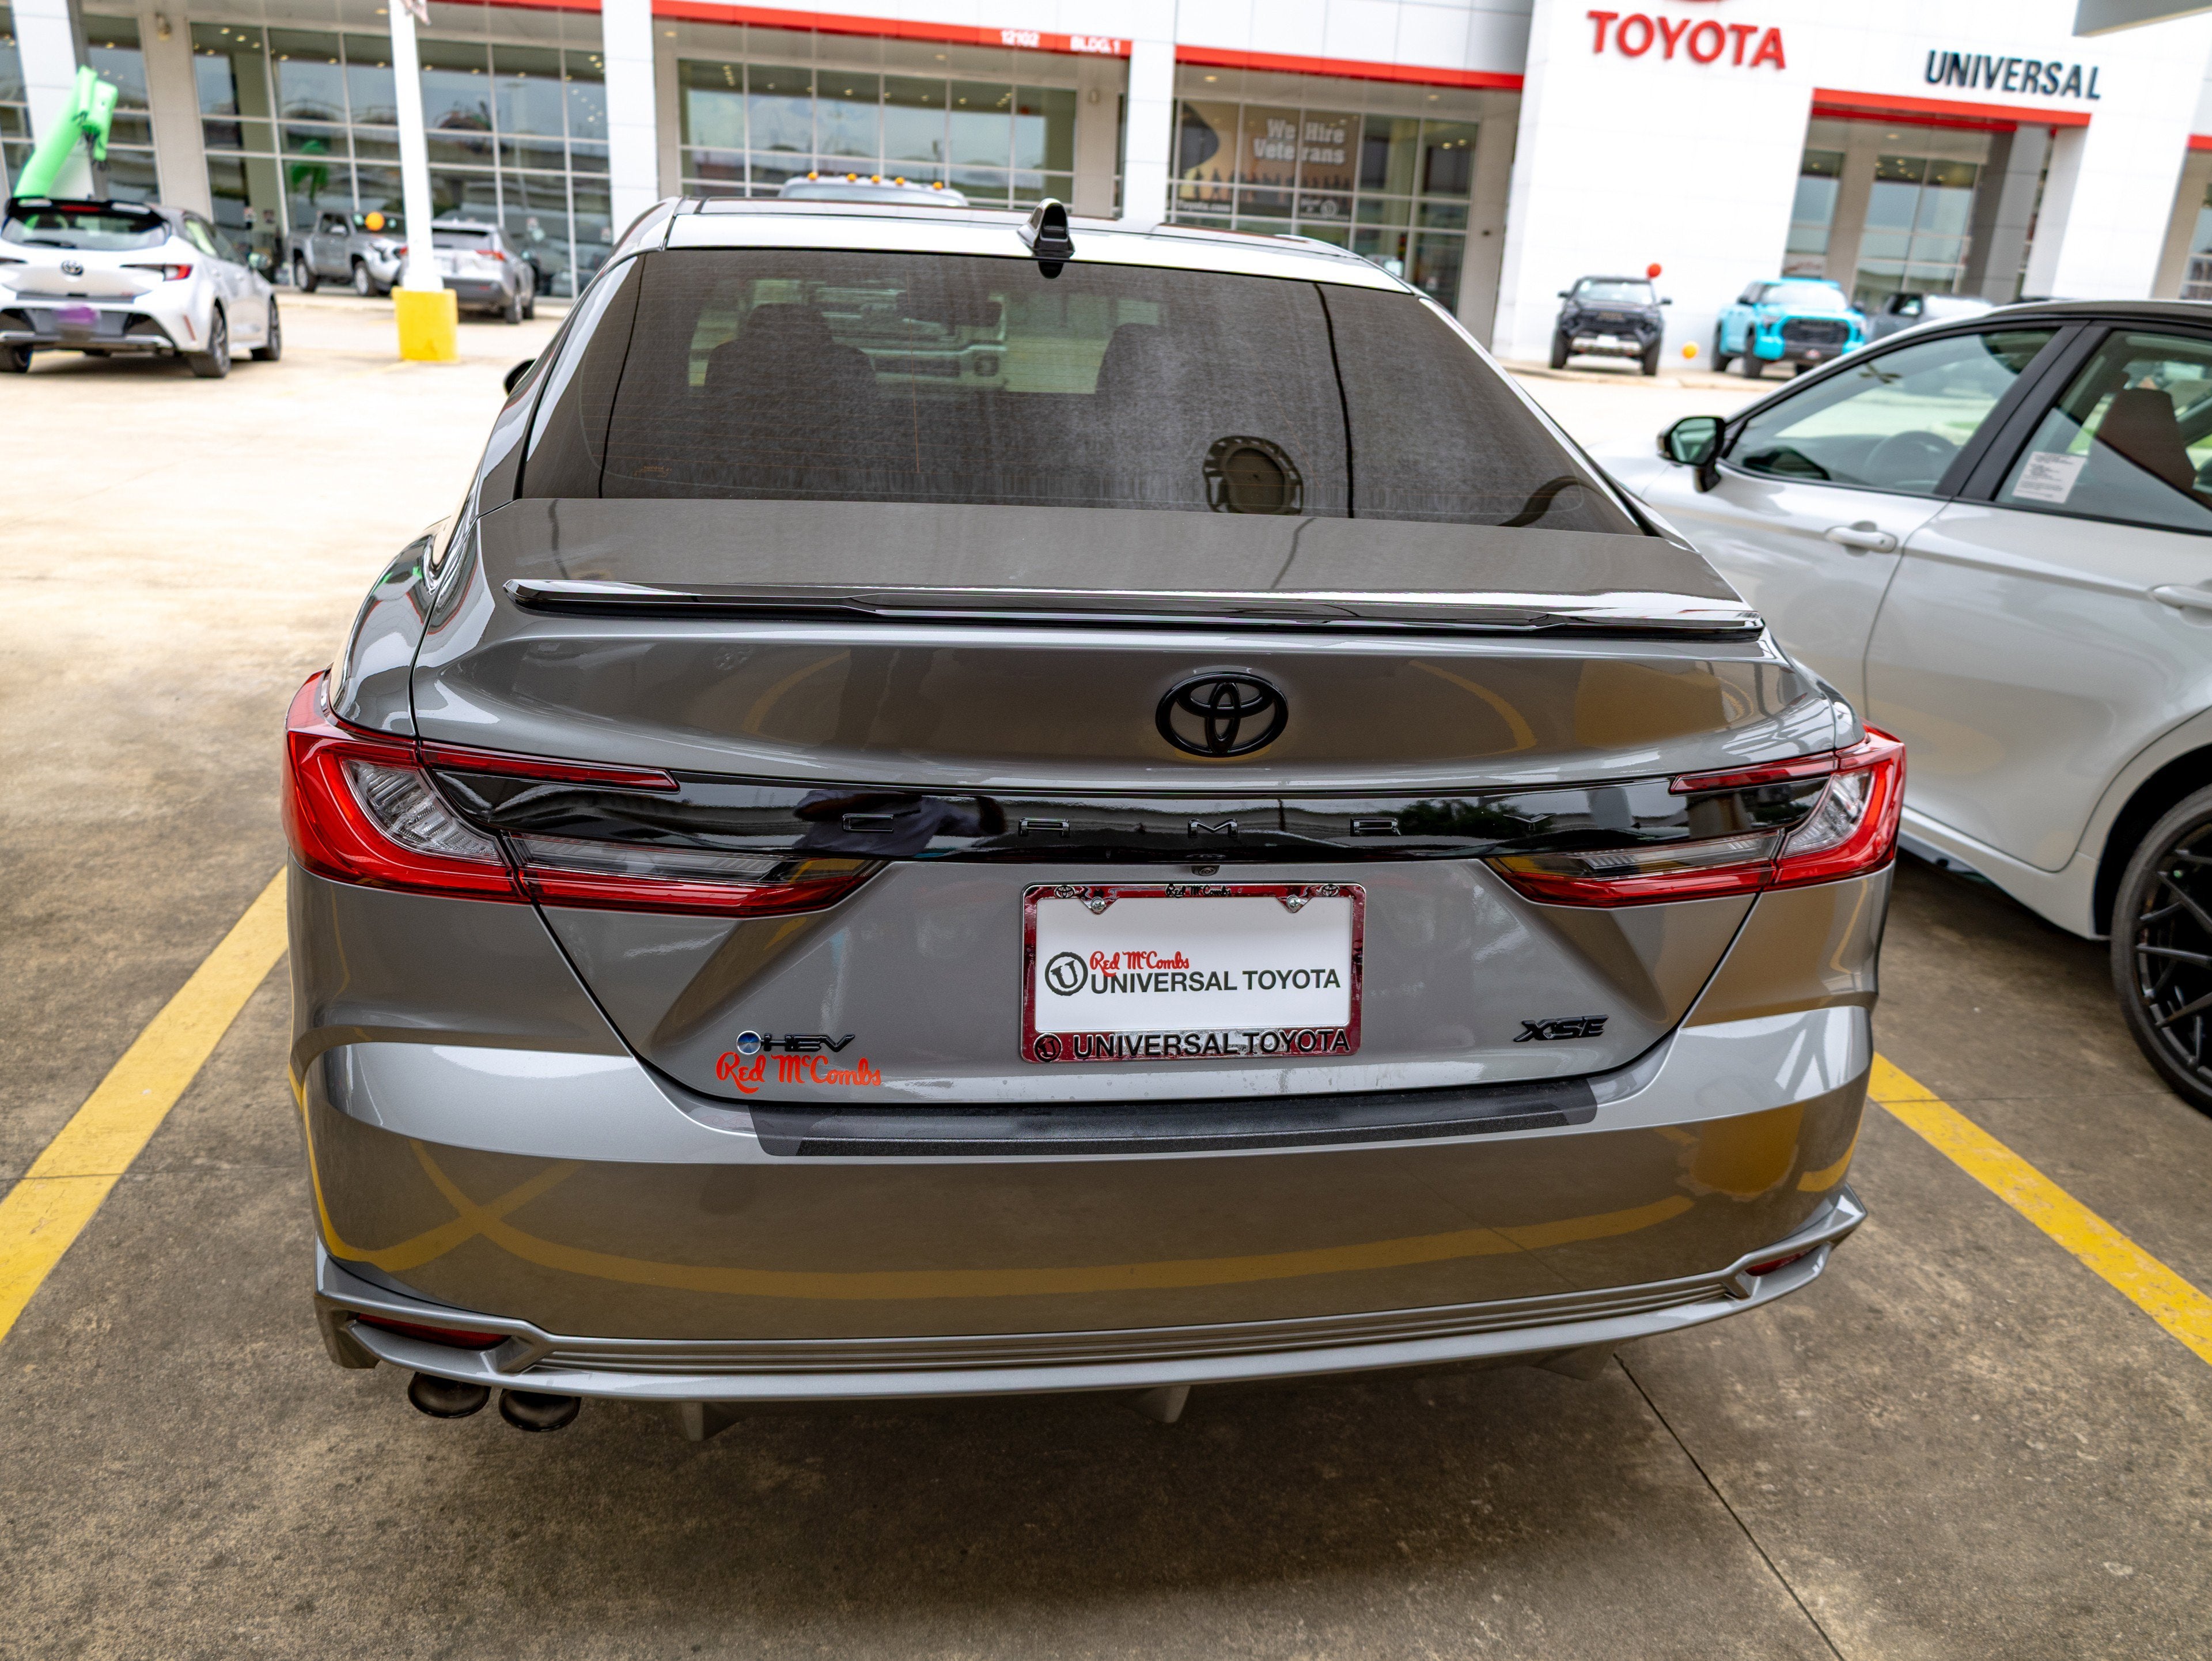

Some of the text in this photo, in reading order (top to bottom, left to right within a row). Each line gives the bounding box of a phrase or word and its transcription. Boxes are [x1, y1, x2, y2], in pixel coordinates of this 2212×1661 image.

[1587, 10, 1786, 70] TOYOTA
[1925, 50, 2101, 100] UNIVERSAL
[1267, 118, 1345, 144] We Hire
[1253, 137, 1346, 165] Veterans
[1165, 883, 1185, 898] Red
[1089, 950, 1190, 977] Red McCombs
[1090, 968, 1341, 994] UNIVERSAL TOYOTA
[1513, 1014, 1609, 1042] XSE
[763, 1032, 856, 1053] HEV
[1073, 1028, 1350, 1059] UNIVERSAL TOYOTA
[715, 1051, 882, 1094] Red McCombs
